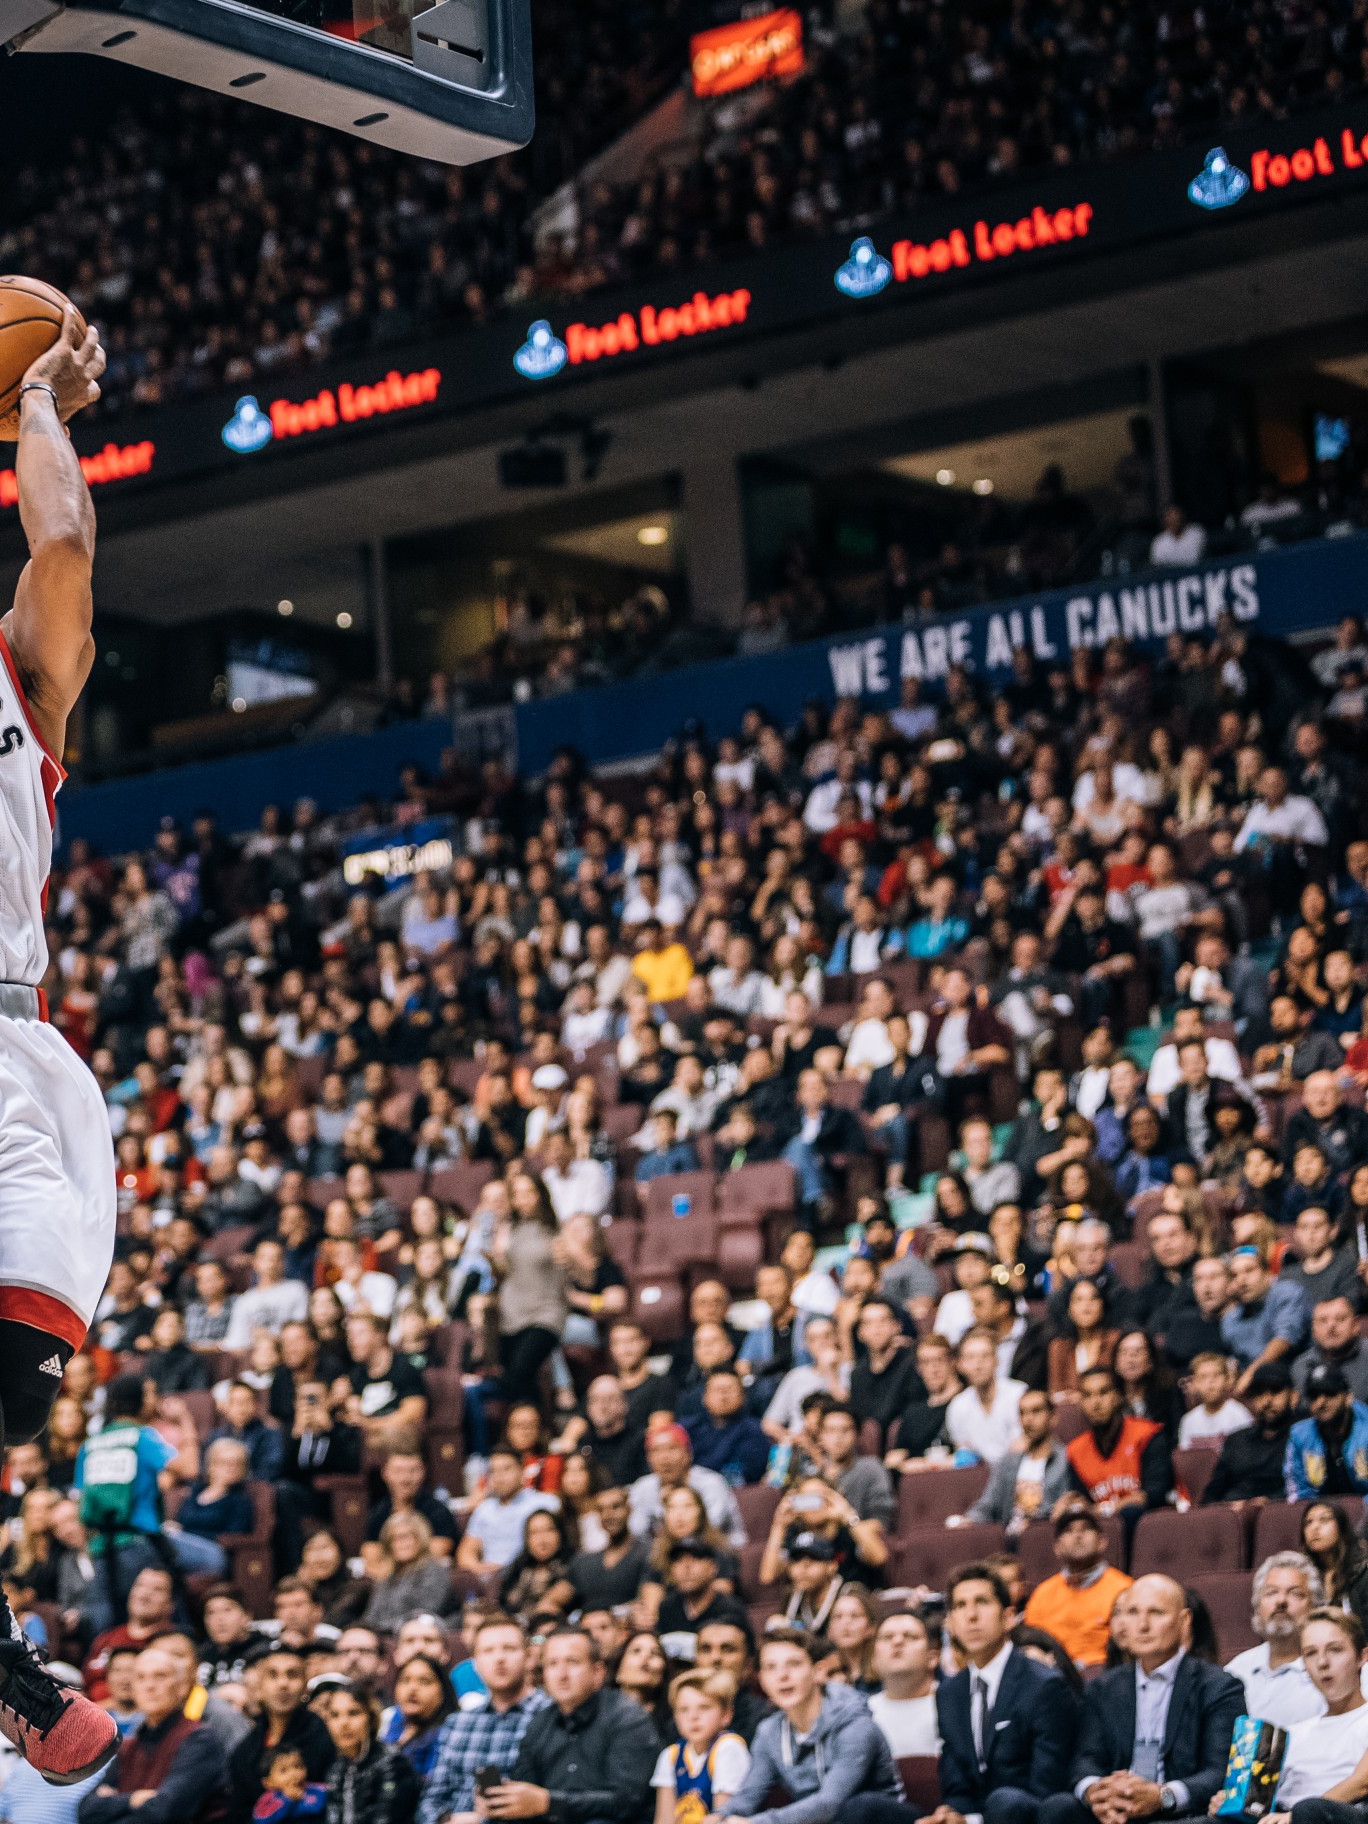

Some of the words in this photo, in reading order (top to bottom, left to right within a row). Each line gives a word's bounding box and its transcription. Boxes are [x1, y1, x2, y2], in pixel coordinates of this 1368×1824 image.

[1252, 139, 1333, 191] Foot
[892, 230, 970, 281] Foot
[975, 203, 1092, 260] Locker
[566, 313, 639, 364] Foot
[641, 289, 750, 344] Locker
[270, 390, 337, 438] Foot
[338, 369, 440, 421] Locker
[829, 638, 890, 697] WE
[900, 620, 974, 684] ARE
[986, 606, 1057, 668] ALL
[1065, 563, 1260, 650] CANUCKS
[38, 1363, 63, 1378] adidas
